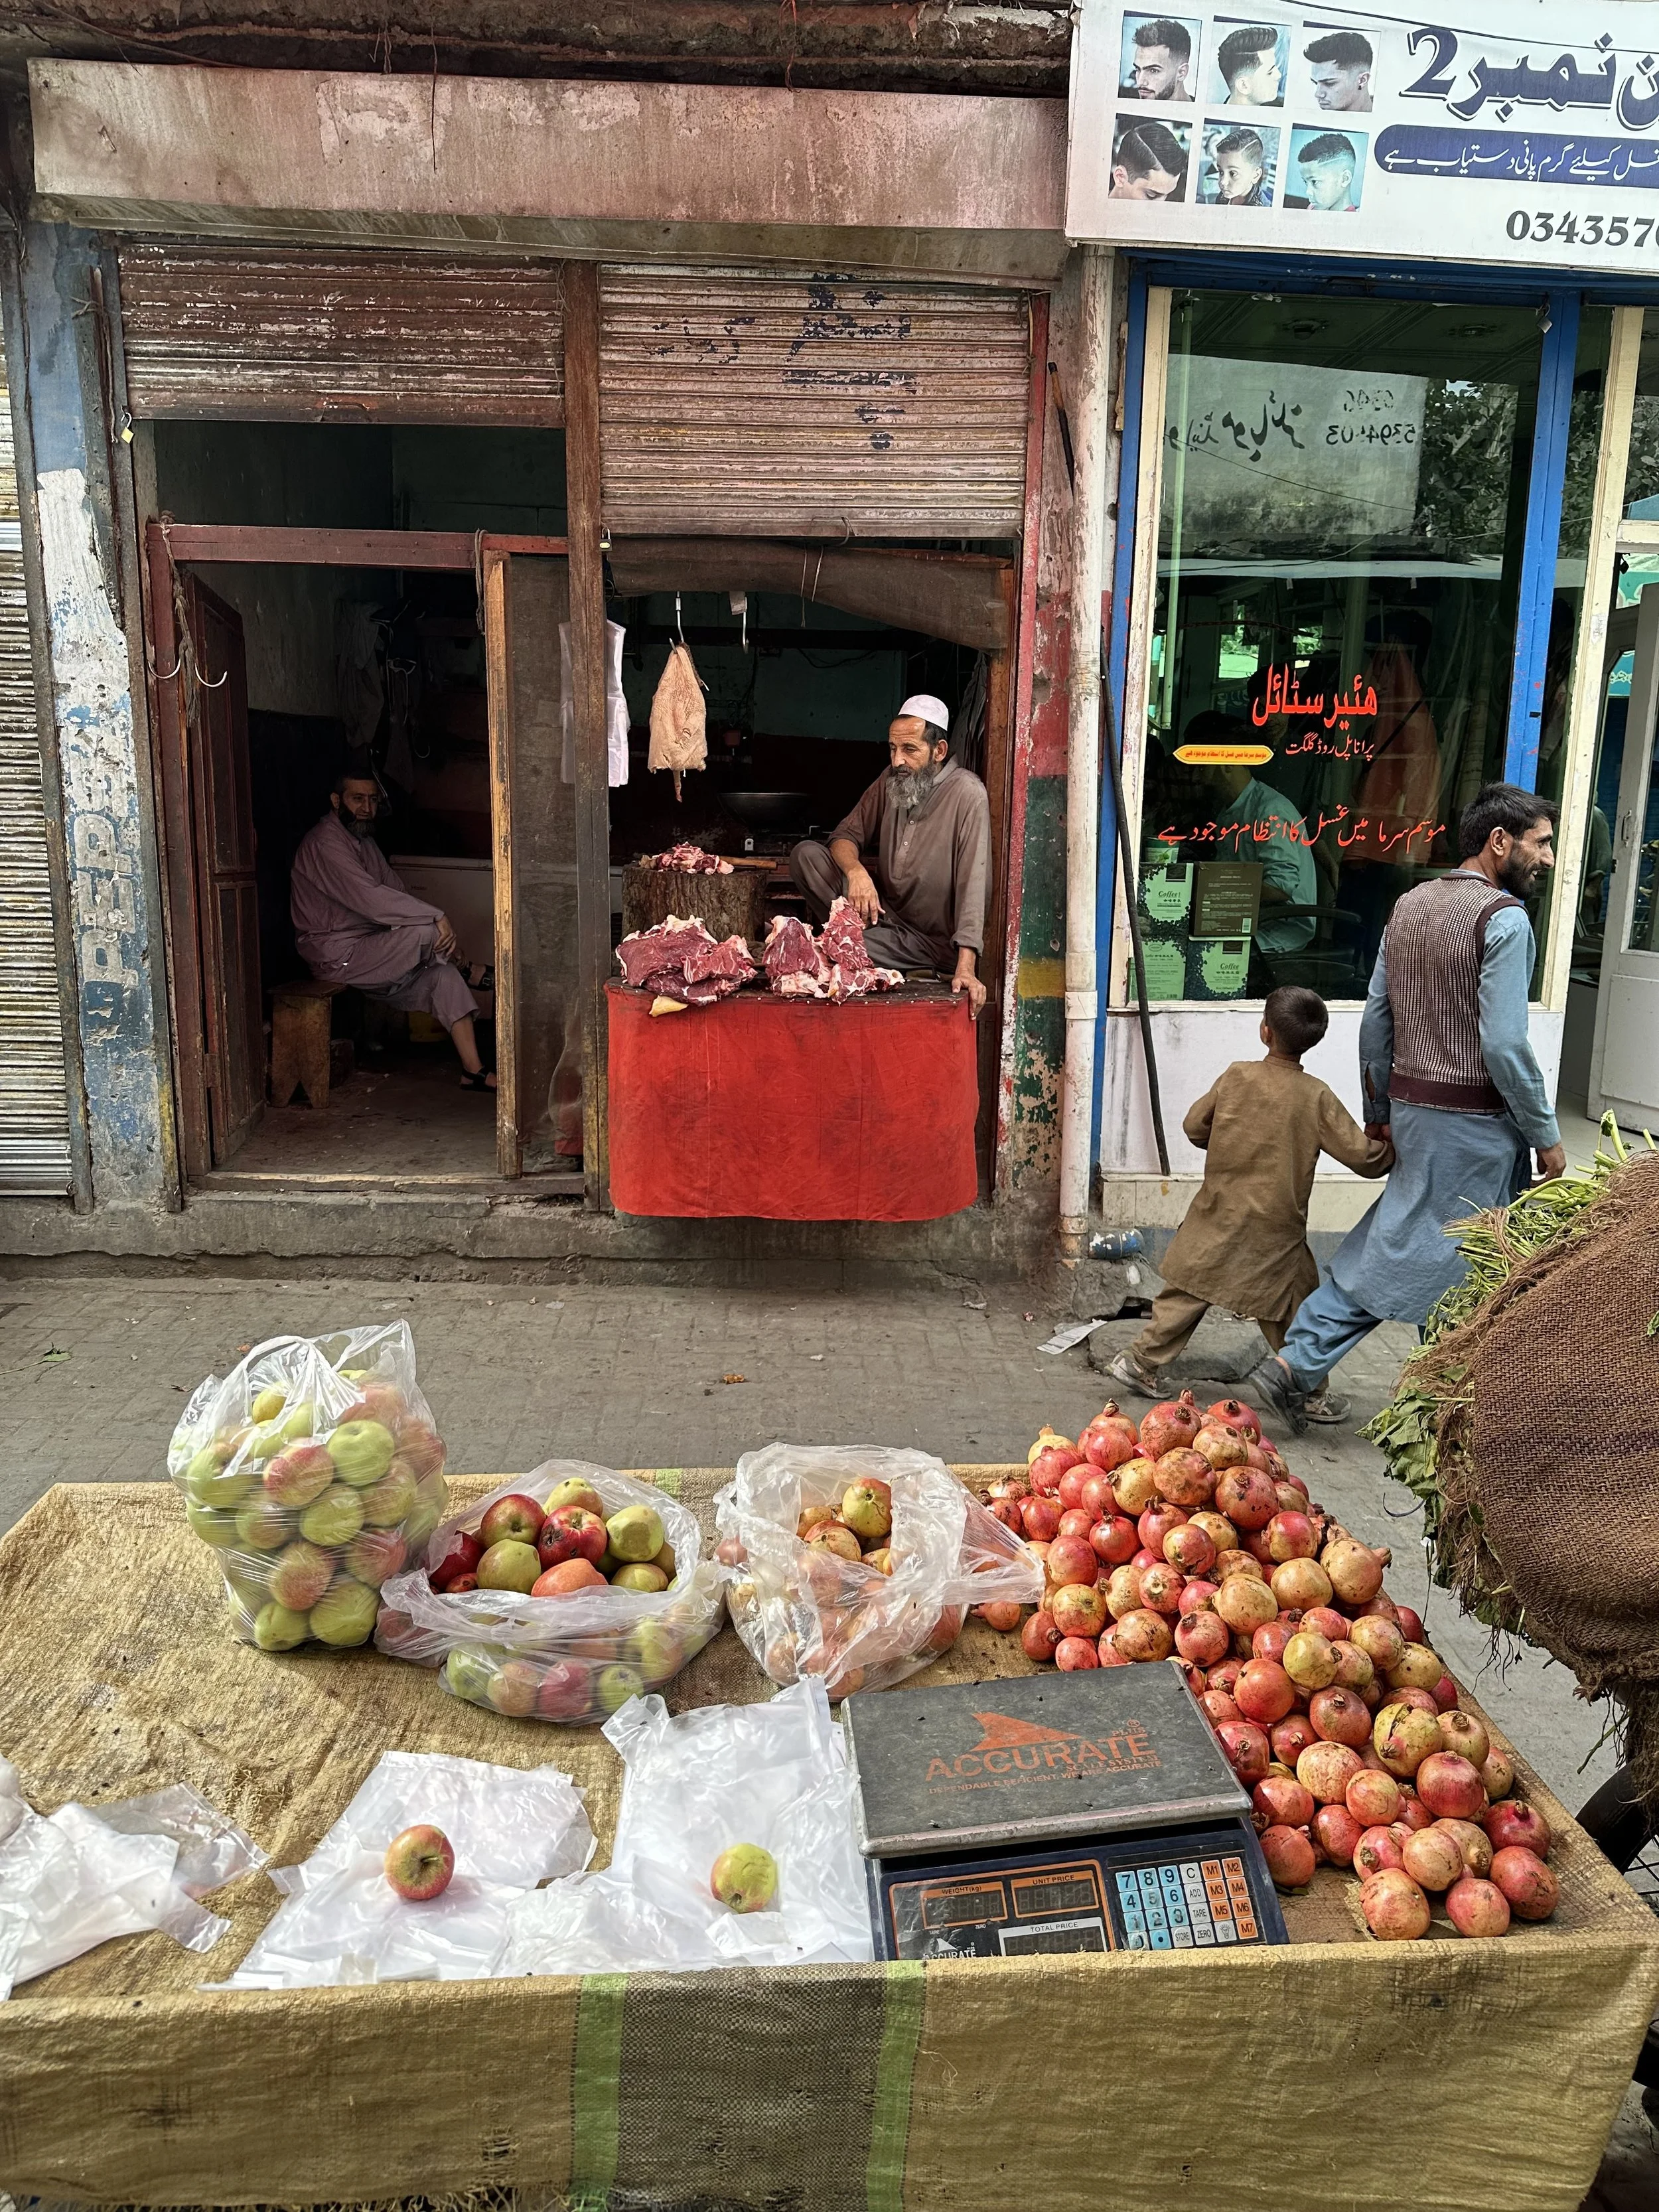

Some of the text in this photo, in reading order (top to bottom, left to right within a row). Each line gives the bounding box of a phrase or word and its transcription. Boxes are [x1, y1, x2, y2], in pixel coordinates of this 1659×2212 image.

[1399, 27, 1458, 101] 2
[1447, 33, 1616, 122] نمبر
[1506, 210, 1659, 248] 034357
[1285, 732, 1319, 755] گلگت
[1158, 826, 1187, 846] ہے
[1189, 822, 1239, 842] موجود
[1301, 804, 1350, 847] غسل
[1337, 817, 1368, 846] میں
[1406, 819, 1446, 854] موسم
[1112, 1727, 1147, 1737] PLUS
[925, 1733, 1155, 1781] ACCURATE
[1106, 1761, 1162, 1773] ACCURATE
[1121, 1863, 1240, 1889] 7 8 9 C M1 M2
[1127, 1882, 1244, 1908] 4 5 6 ADD M3 M4
[1151, 1911, 1163, 1926] 2
[1173, 1908, 1184, 1923] 3
[1192, 1908, 1207, 1918] TARE
[1215, 1905, 1228, 1915] M5
[1236, 1902, 1249, 1911] M6
[1030, 1925, 1054, 1933] TOTAL
[1175, 1931, 1190, 1942] STORE
[1196, 1929, 1211, 1939] ZERO
[1241, 1923, 1253, 1933] M7
